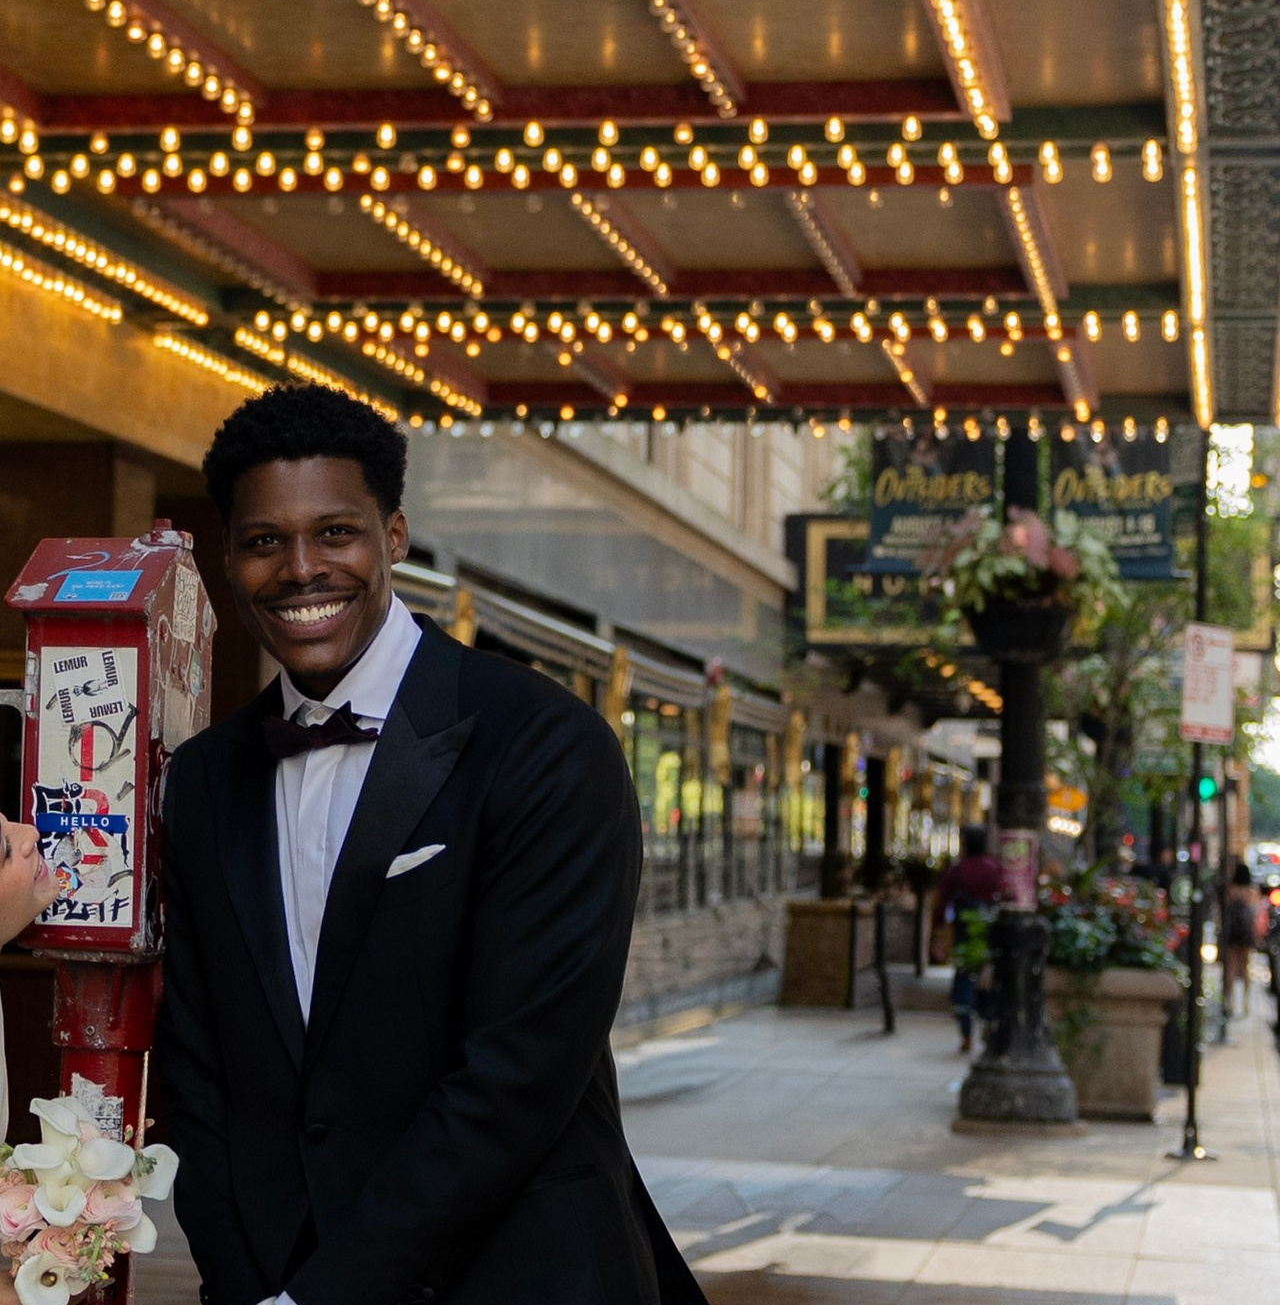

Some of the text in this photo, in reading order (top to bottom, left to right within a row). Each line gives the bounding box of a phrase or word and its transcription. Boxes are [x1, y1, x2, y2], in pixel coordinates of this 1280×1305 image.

[53, 656, 88, 674] LEMUR
[102, 650, 119, 687] LEMUR
[58, 687, 74, 724] LEMUR
[89, 701, 124, 718] LEMUR
[60, 816, 110, 827] HELLO
